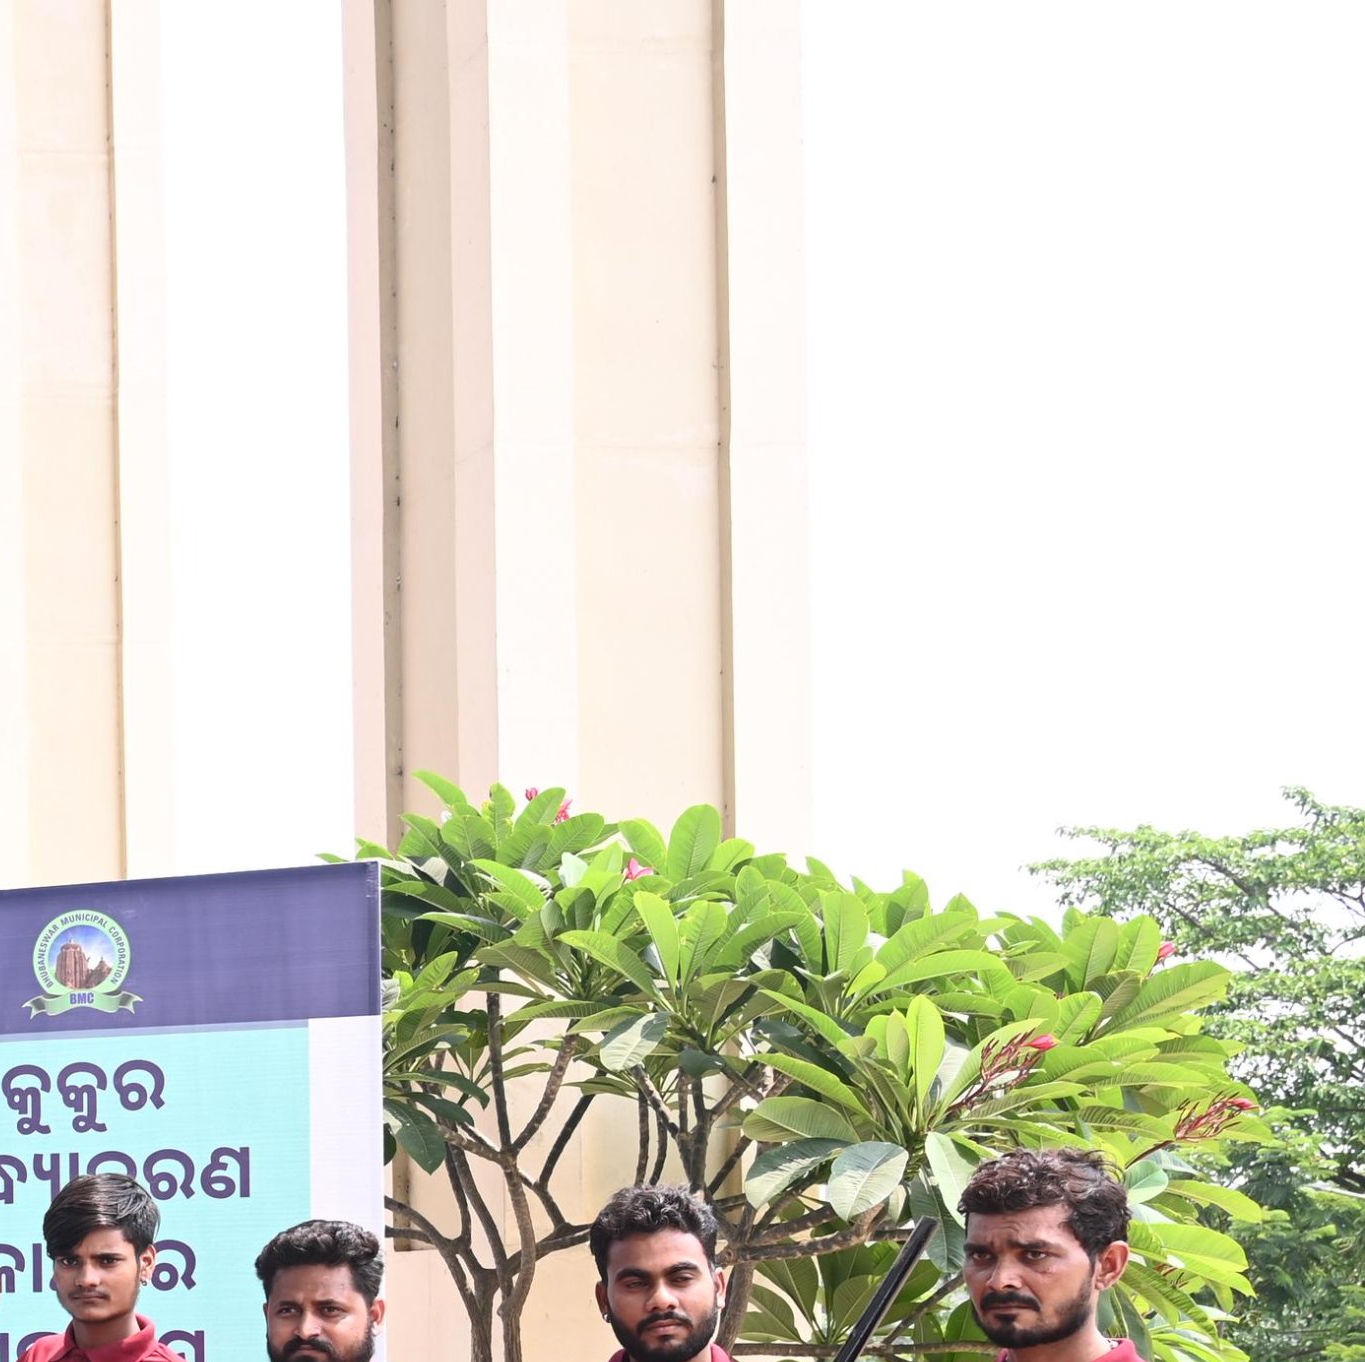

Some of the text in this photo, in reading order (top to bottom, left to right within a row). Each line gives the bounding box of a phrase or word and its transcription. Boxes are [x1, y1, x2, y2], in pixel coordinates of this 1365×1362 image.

[37, 913, 127, 989] BHUBANESWAR MUNICIPAL CORPORATION
[69, 992, 94, 1005] BMC
[0, 1058, 166, 1135] କୁକୁର
